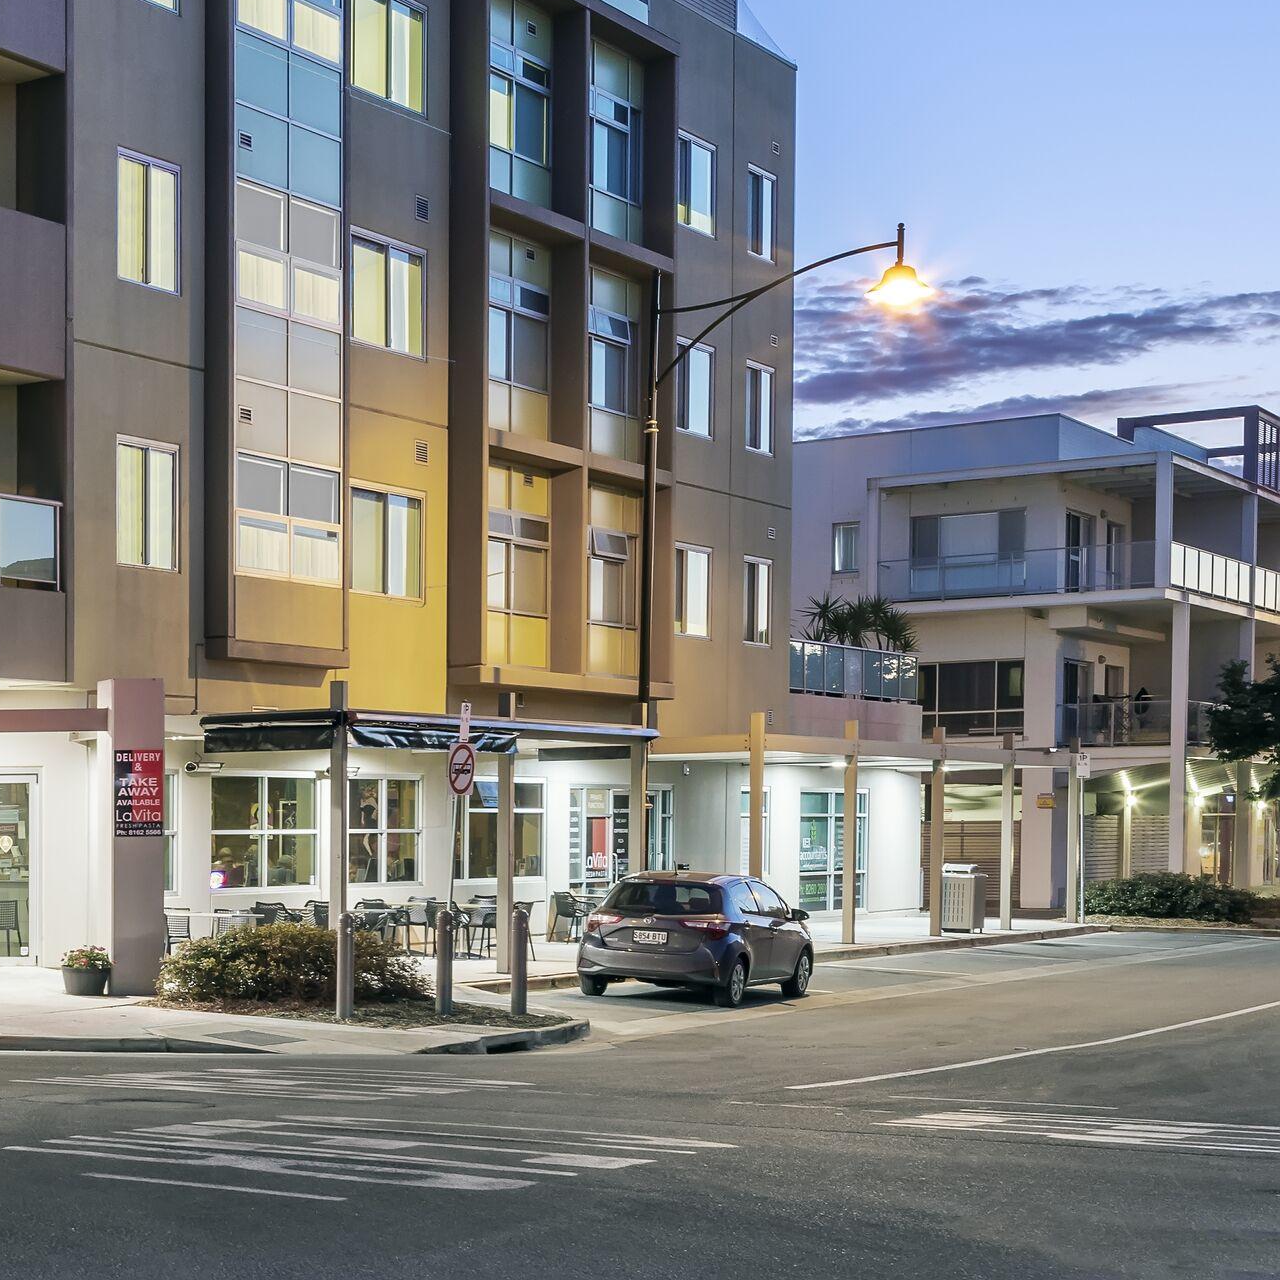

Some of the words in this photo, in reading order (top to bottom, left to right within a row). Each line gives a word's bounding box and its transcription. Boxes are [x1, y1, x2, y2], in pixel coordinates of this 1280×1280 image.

[116, 753, 161, 762] DELIVERY
[134, 762, 142, 771] &
[119, 777, 158, 787] TAKE
[118, 787, 159, 797] AWAY
[115, 809, 161, 822] LaVita
